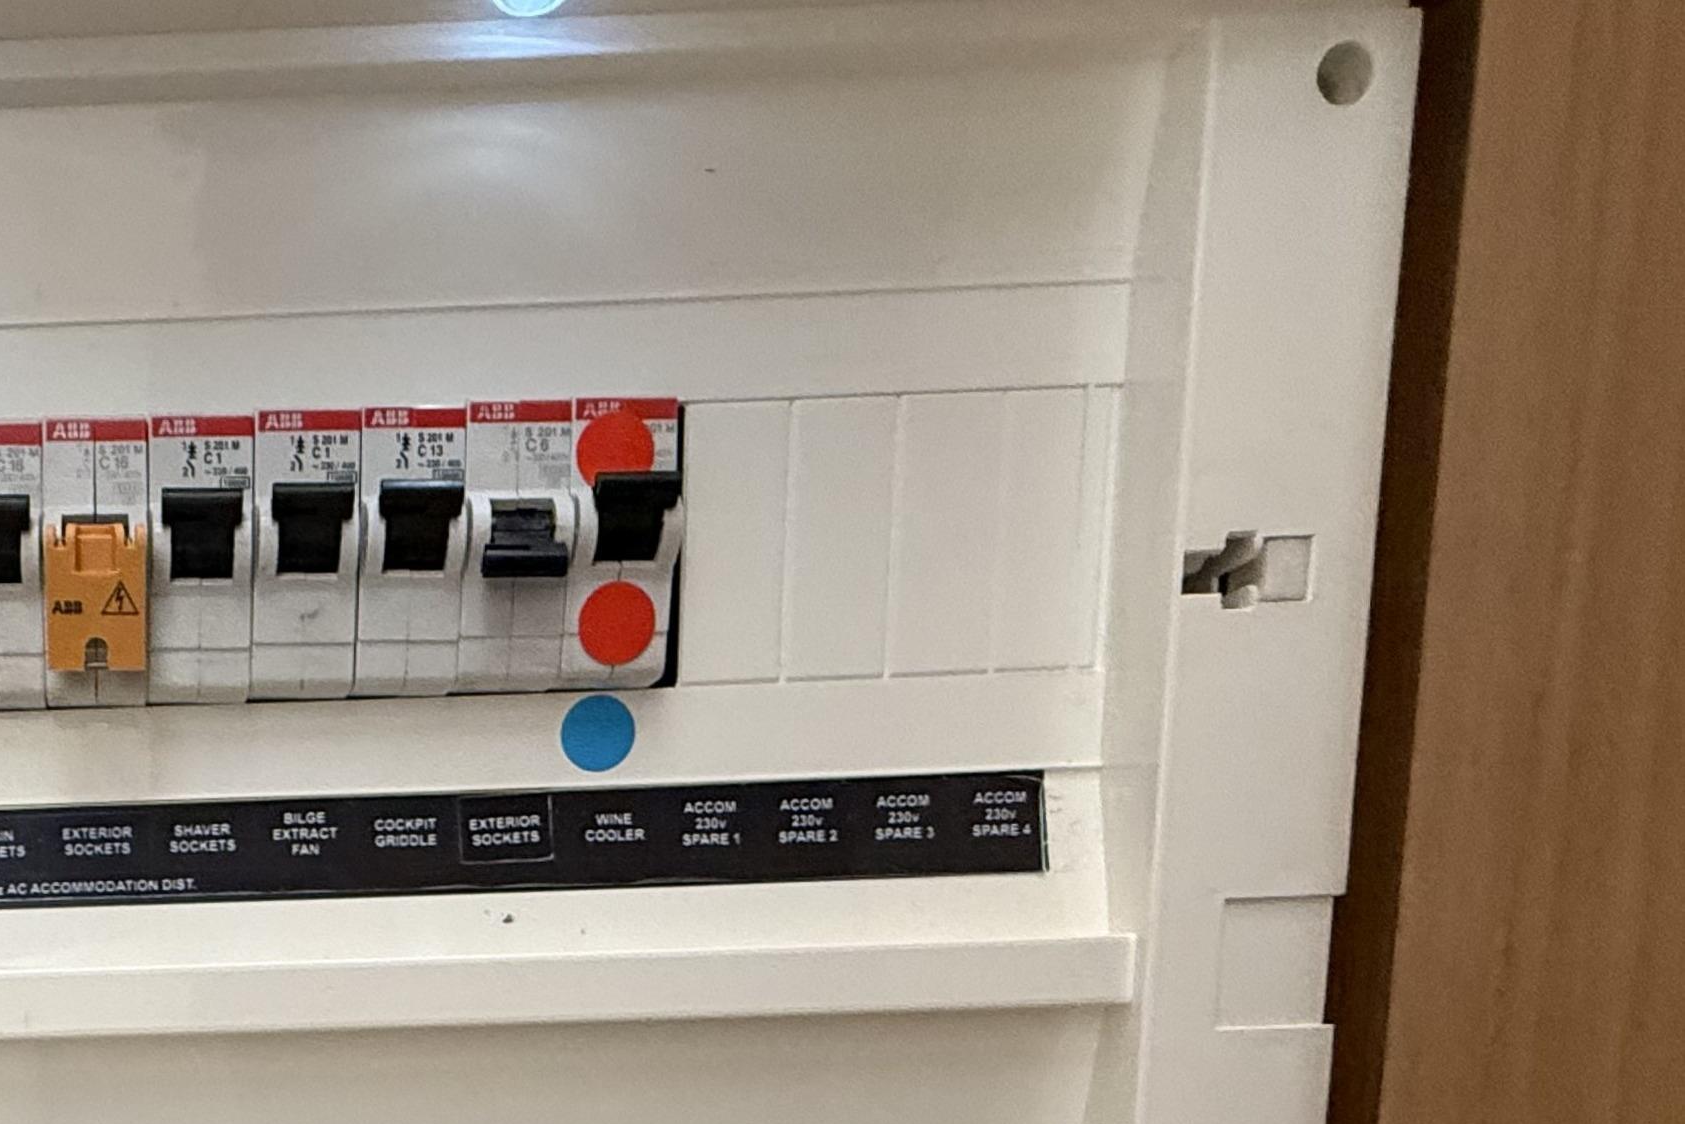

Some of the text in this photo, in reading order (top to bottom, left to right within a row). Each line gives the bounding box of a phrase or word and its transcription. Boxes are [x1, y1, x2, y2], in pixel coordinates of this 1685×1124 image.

[371, 410, 410, 425] ABB
[477, 405, 515, 419] ABB
[264, 413, 303, 428] ABB
[52, 423, 91, 438] ABB
[158, 420, 197, 435] ABB
[417, 446, 443, 456] C 13
[53, 601, 83, 614] ABB
[876, 795, 931, 808] ACCOM
[973, 791, 1027, 804] ACCOM
[683, 801, 737, 814] ACCOM
[780, 798, 834, 811] ACCOM
[283, 812, 326, 825] BILGE
[595, 813, 632, 826] WINE
[791, 815, 823, 826] 230v
[888, 811, 919, 824] 230v
[985, 808, 1016, 820] 230v
[374, 818, 437, 831] COCKPIT
[469, 815, 541, 830] EXTERIOR
[695, 818, 726, 830] 230v
[62, 826, 132, 840] EXTERIOR
[174, 824, 230, 837] SHAVER
[272, 827, 338, 841] EXTRACT
[585, 828, 645, 842] COOLER
[778, 830, 838, 843] SPARE 2
[875, 827, 935, 840] SPARE 3
[972, 824, 1031, 837] SPARE 4
[375, 834, 437, 847] GRIDDLE
[472, 831, 540, 846] SOCKETS
[682, 833, 741, 846] SPARE 1
[64, 843, 131, 856] SOCKETS
[170, 839, 236, 853] SOCKETS
[291, 844, 320, 855] FAN
[6, 883, 28, 895] AC
[31, 880, 158, 894] ACCOMMODATION
